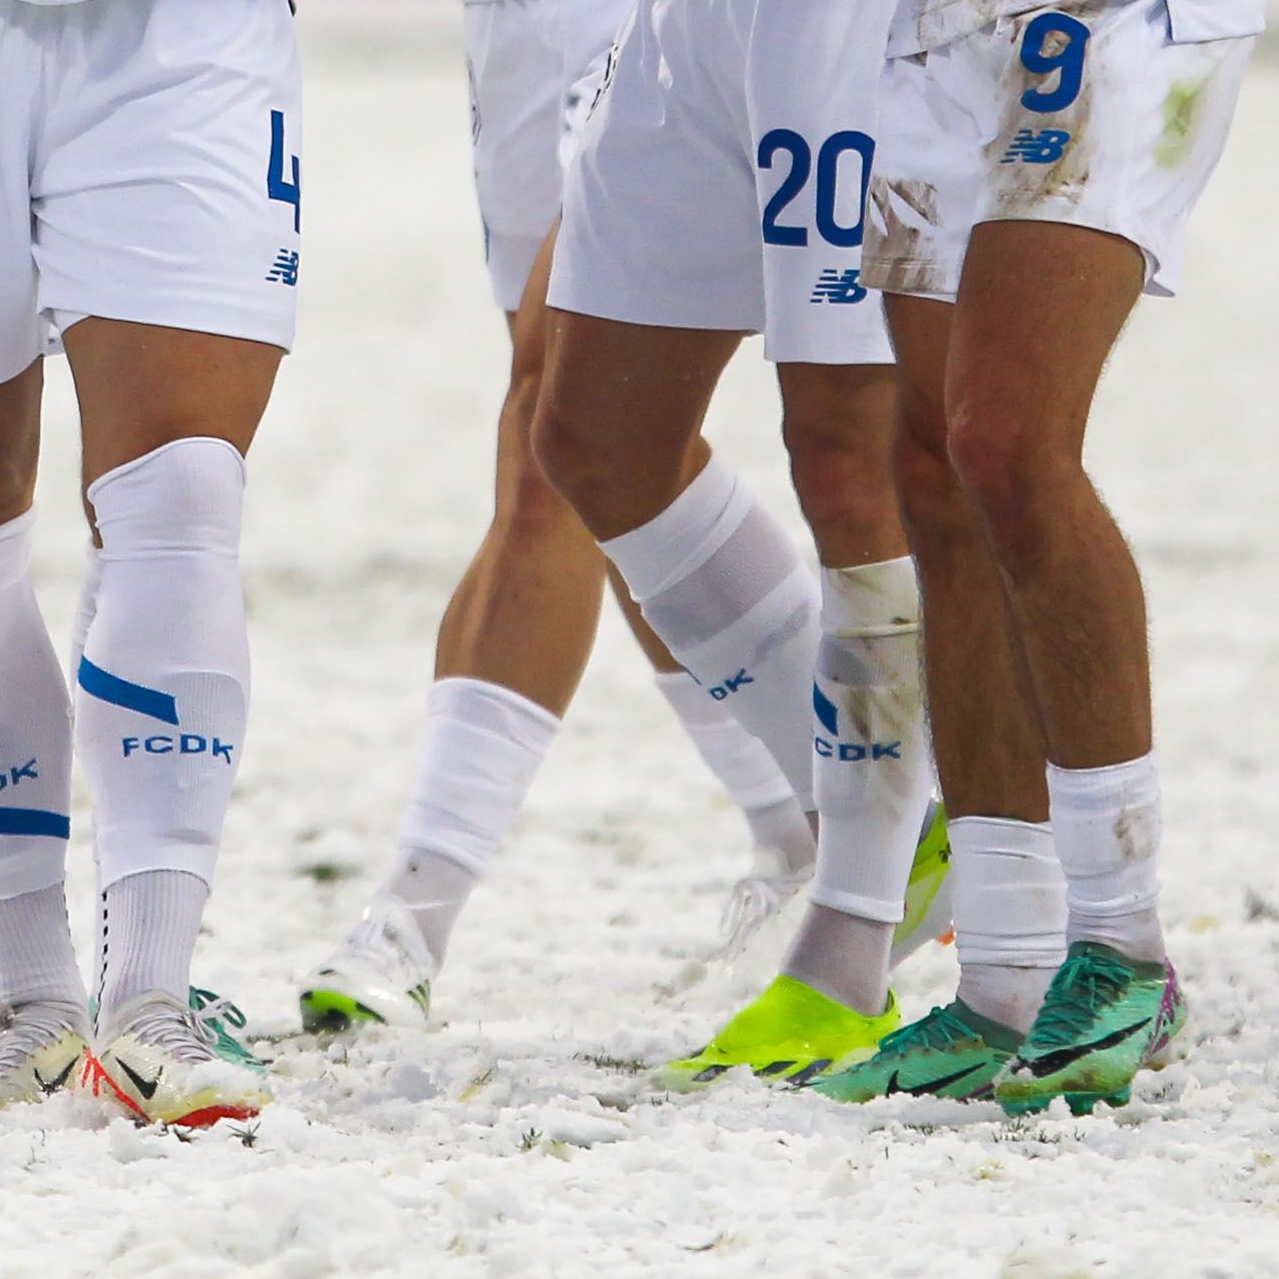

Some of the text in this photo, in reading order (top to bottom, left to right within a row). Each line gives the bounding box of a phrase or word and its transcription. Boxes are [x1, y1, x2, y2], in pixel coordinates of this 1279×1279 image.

[1020, 12, 1091, 113] 9
[757, 128, 876, 246] 20
[122, 734, 233, 764] FCDK
